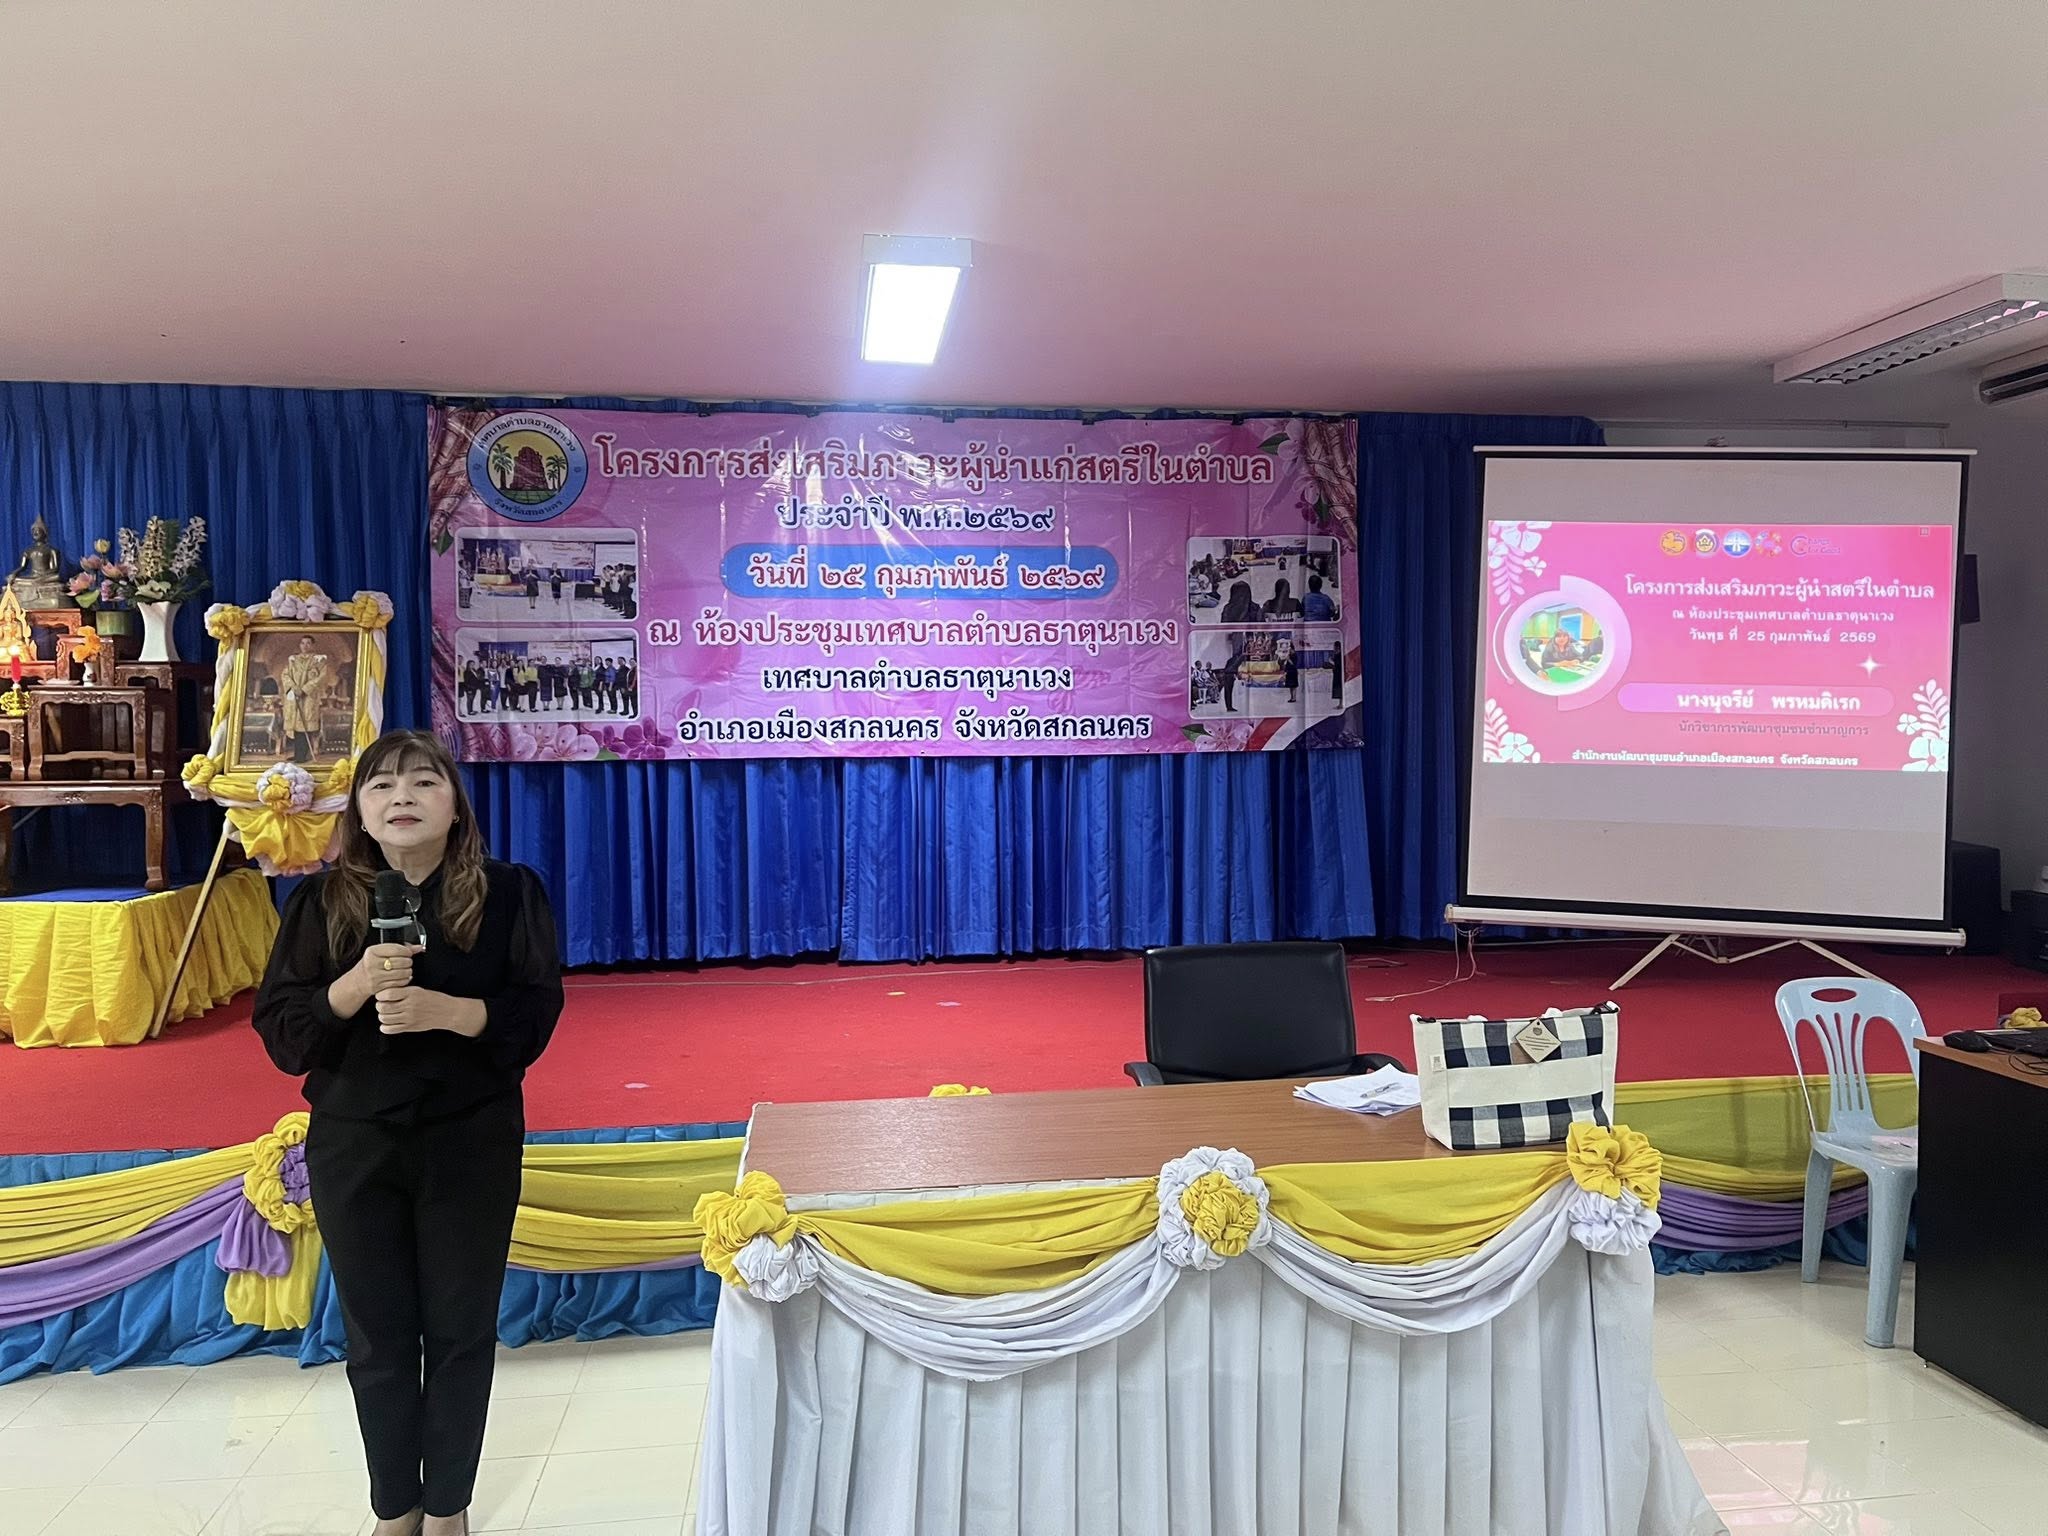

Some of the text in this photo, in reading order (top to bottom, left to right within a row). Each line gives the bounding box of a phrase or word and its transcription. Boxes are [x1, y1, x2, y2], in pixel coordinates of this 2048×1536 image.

[594, 434, 1273, 490] โครงการส่งเสริมภาวะผู้นำแก่สตรีในตำบล
[777, 495, 1054, 531] ประจำปี พ.ศ.๒๕๖๙
[748, 549, 1106, 598] วันที่ ๒๕ กุมภาพันธ์ ๒๕๖๙
[1624, 573, 1935, 602] โครงการส่งเสริมภาวะผู้นำสตรีในตำบล
[648, 608, 1177, 653] ณ ห้องประชุมเทศบาลตำบลธาตุนาเวง
[1672, 606, 1895, 624] ณ ห้องประชุมเทศบาลตำบลธาตุนาเวง
[1689, 627, 1876, 645] วันพุธ ที่ 25 กุมภาพันธ์ 2569
[763, 662, 1072, 700] เทศบาลตำบลธาตุนาเวง
[679, 708, 1152, 743] อำเภอเมืองสกลนคร จังหวัดสกลนคร
